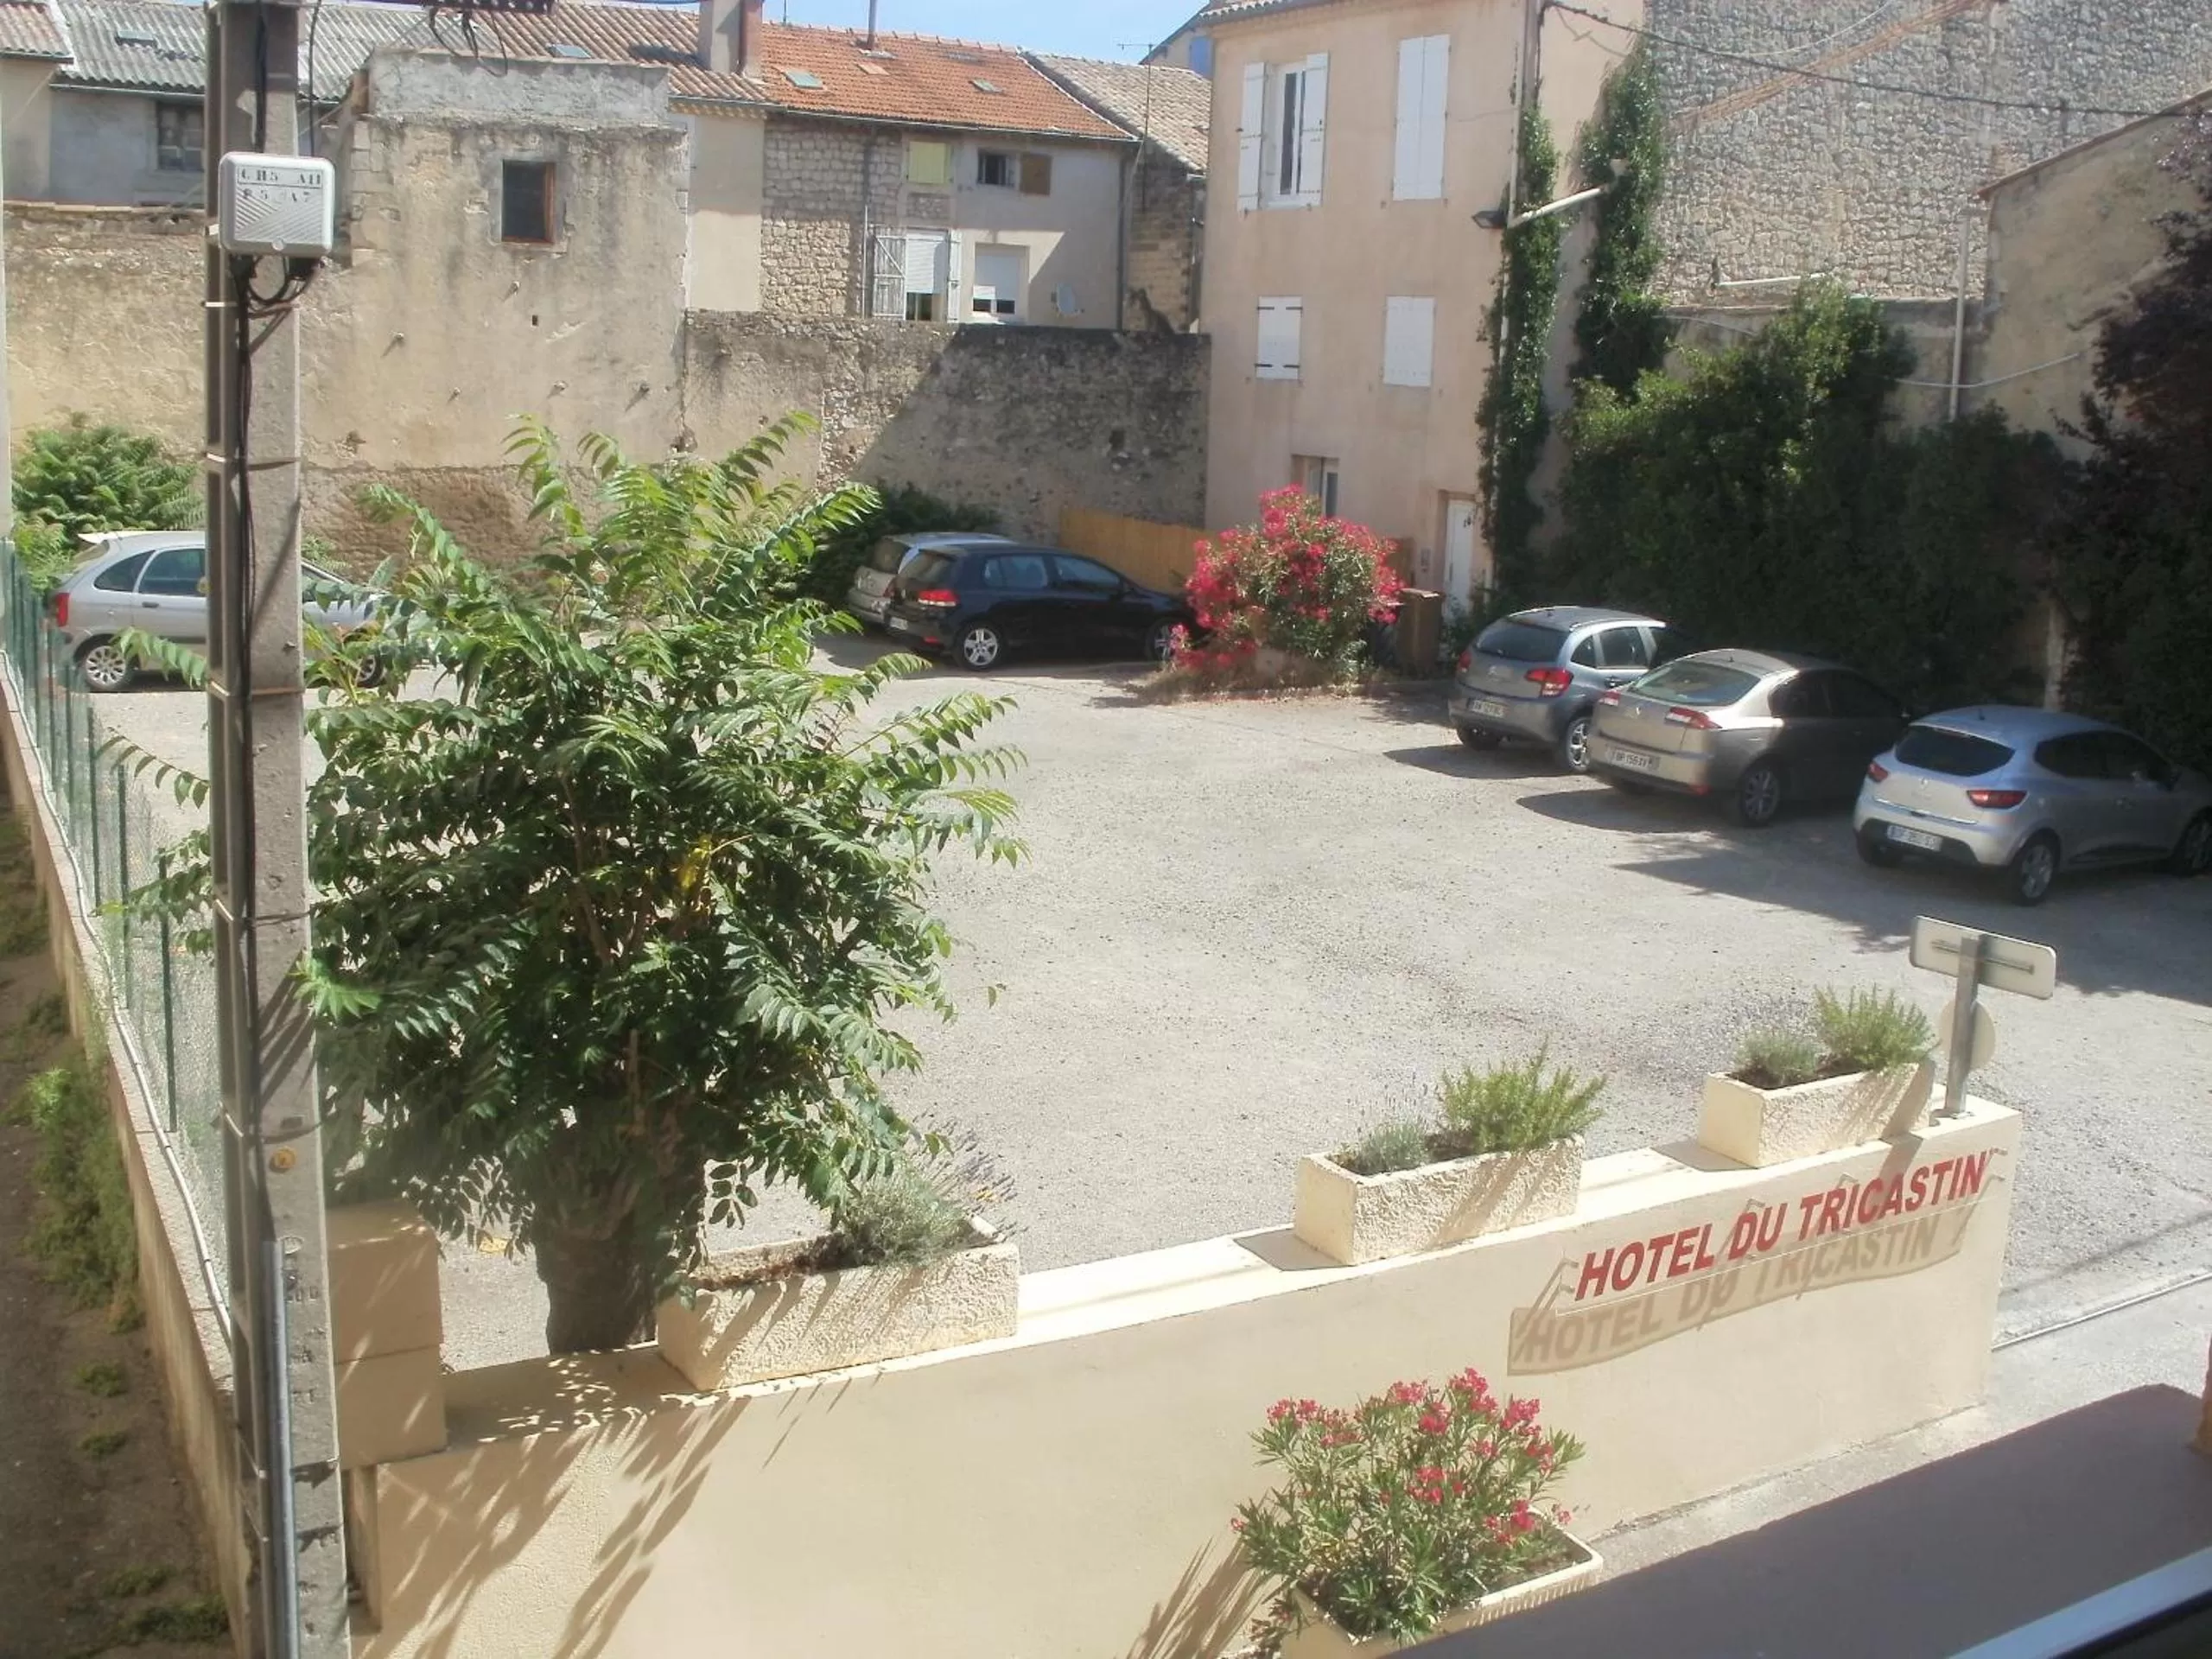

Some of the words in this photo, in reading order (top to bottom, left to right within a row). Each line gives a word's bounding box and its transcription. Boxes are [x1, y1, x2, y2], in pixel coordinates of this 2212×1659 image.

[1574, 1223, 1714, 1301] HOTEL
[1728, 1203, 1788, 1260] DU
[1798, 1150, 1987, 1242] TRICASTIN
